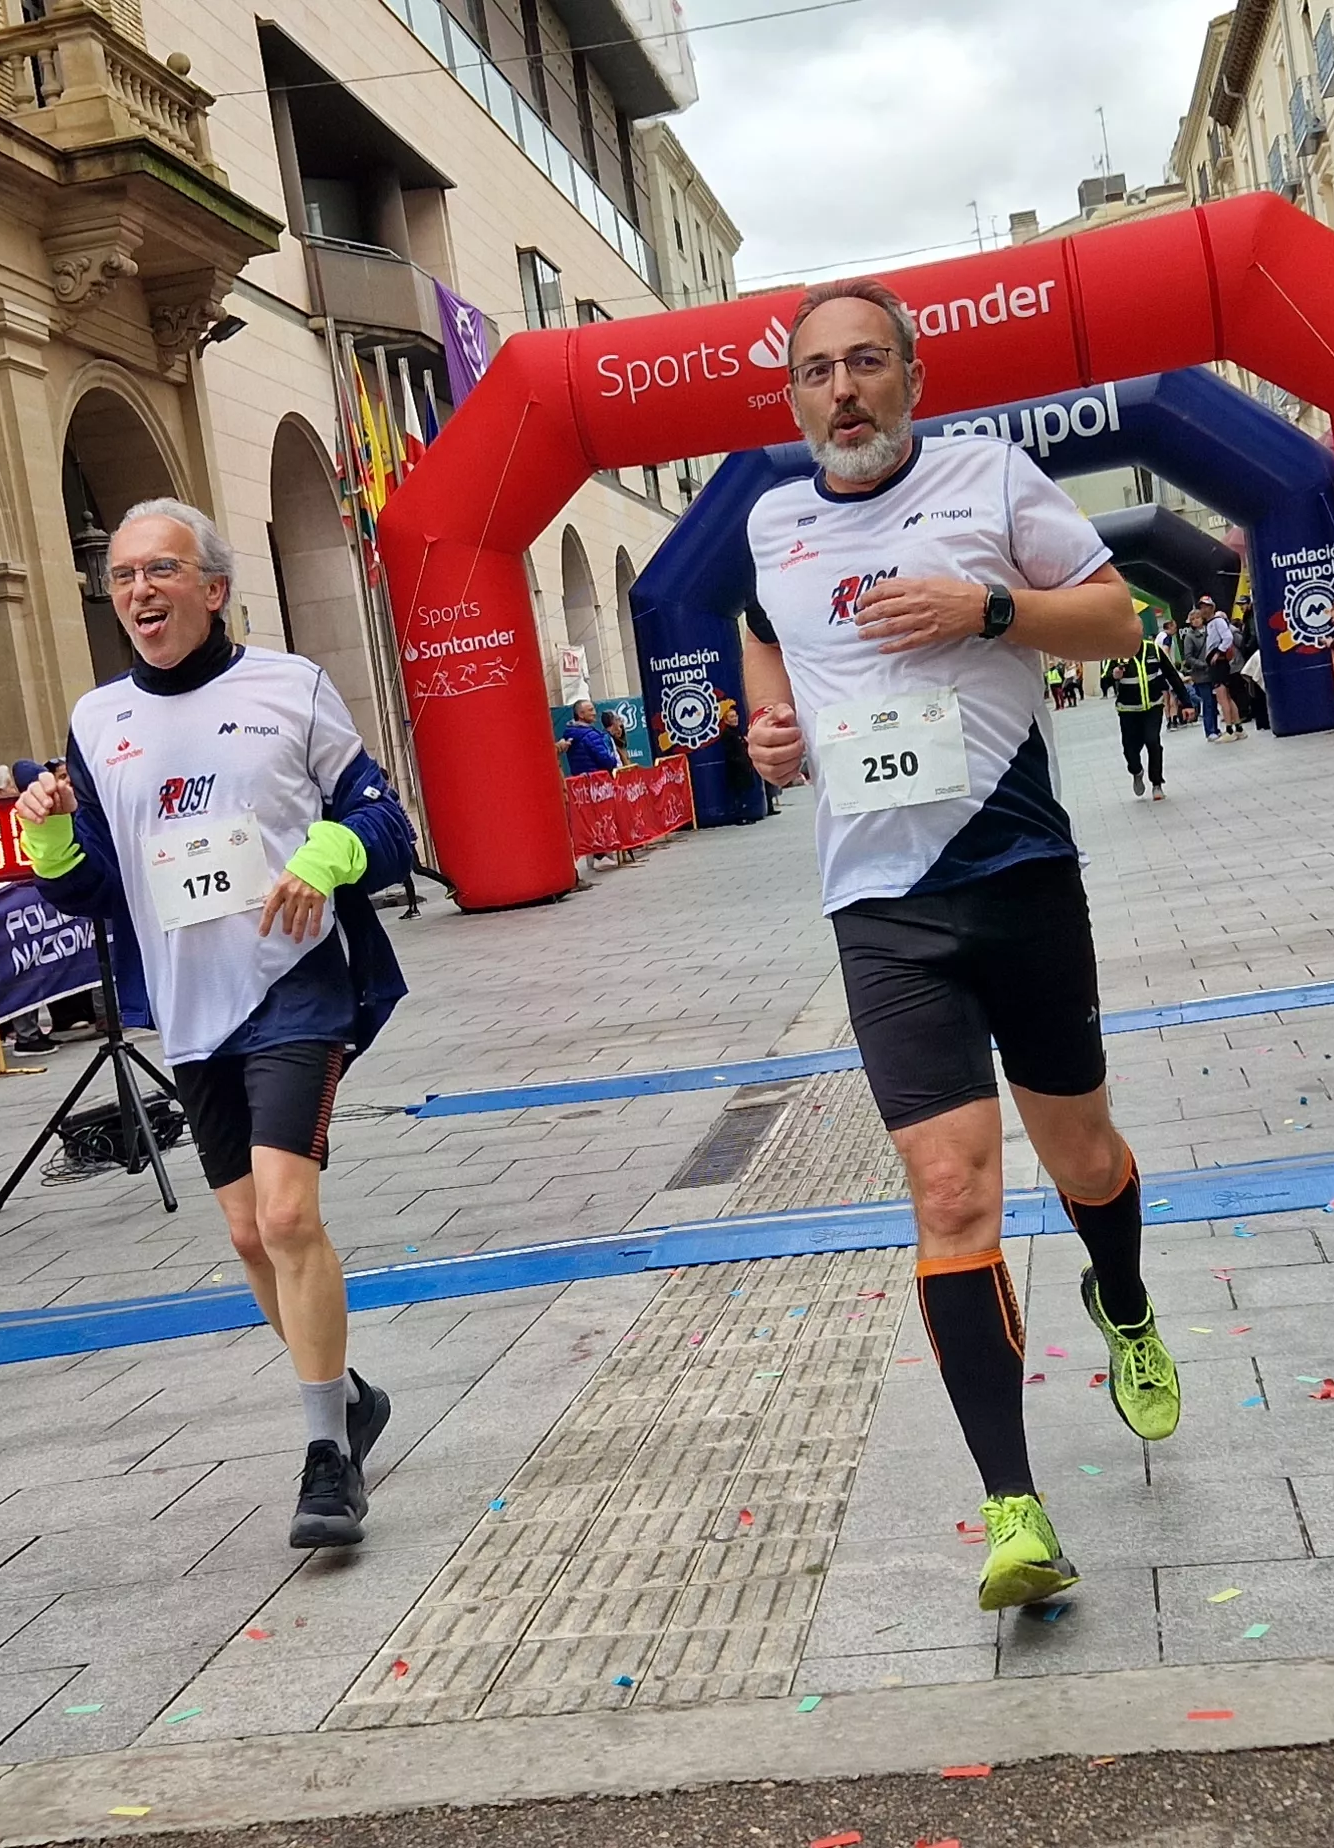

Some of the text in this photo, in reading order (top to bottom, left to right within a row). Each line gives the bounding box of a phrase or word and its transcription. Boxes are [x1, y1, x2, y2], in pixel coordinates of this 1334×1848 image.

[596, 280, 1055, 404] Sports ander
[931, 507, 972, 521] mupol
[418, 600, 481, 628] Sports
[420, 629, 515, 660] Santander
[650, 648, 719, 672] fundación
[661, 664, 707, 685] mupol
[244, 725, 279, 737] mupol
[862, 751, 919, 784] 250
[182, 870, 231, 900] 178
[6, 902, 75, 941] POLI
[11, 921, 113, 976] NACIONA
